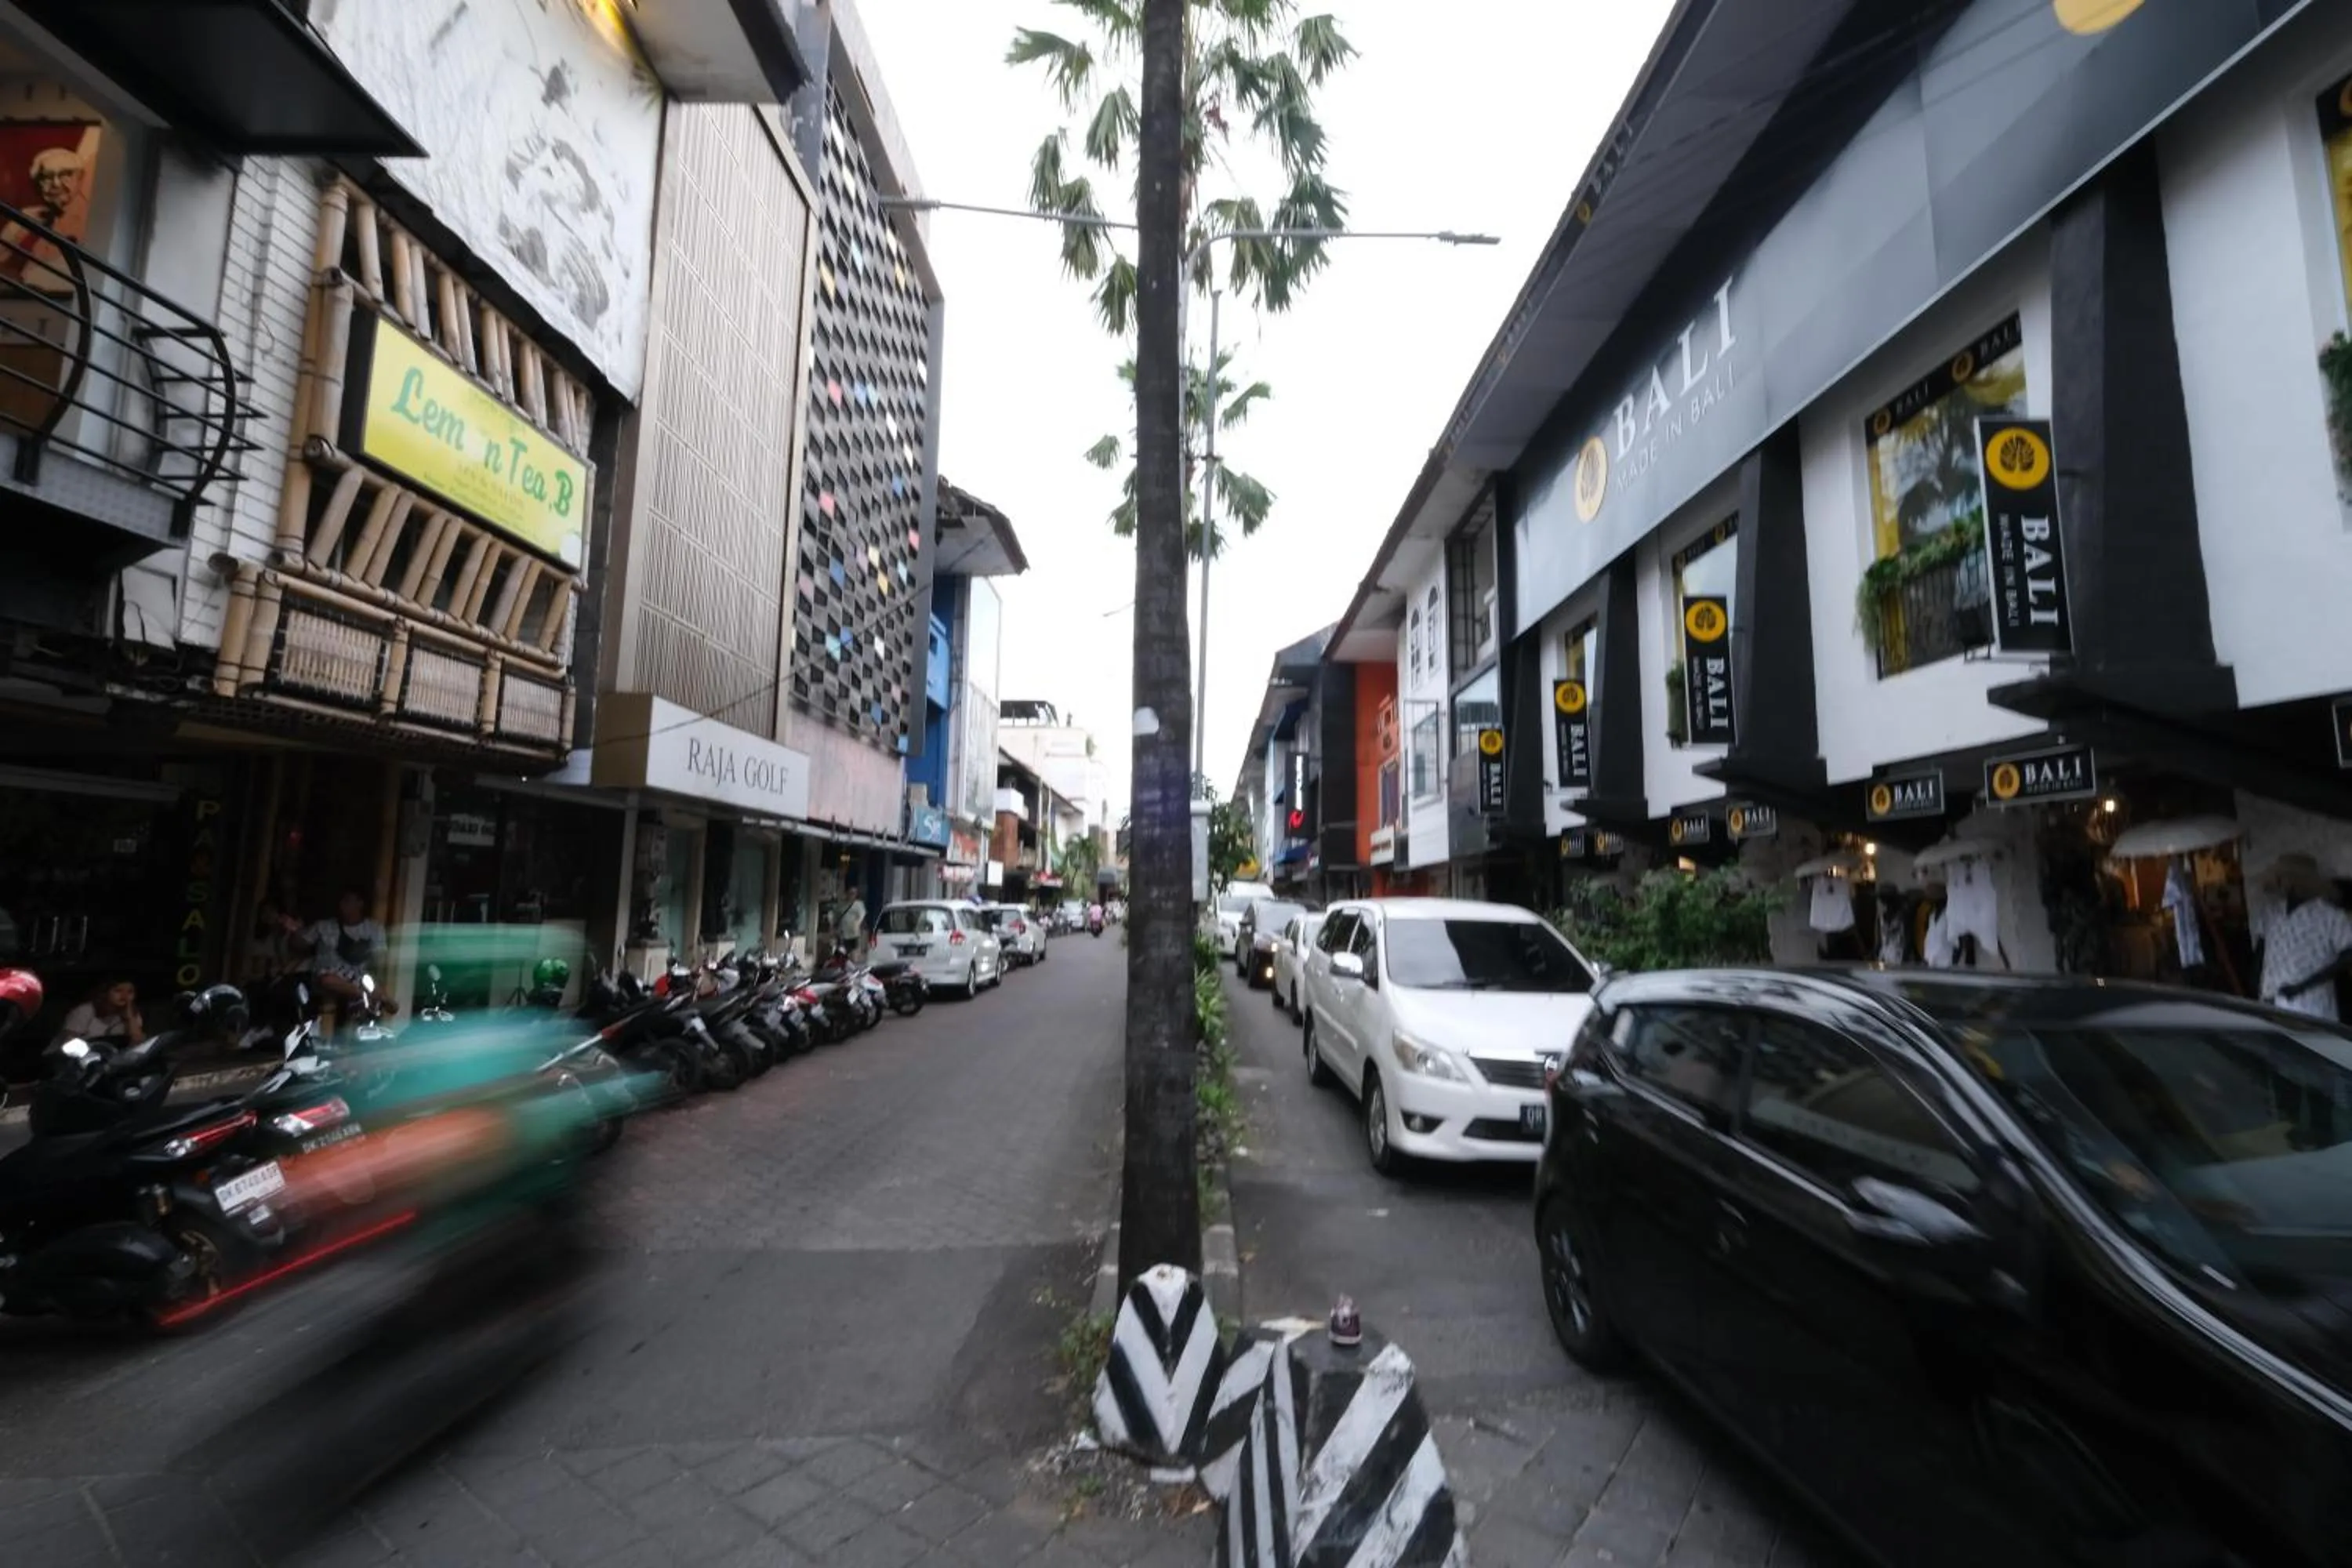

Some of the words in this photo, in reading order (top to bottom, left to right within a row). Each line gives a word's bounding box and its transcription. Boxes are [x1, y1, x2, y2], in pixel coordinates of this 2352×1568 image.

[1613, 276, 1736, 463] BALI
[1666, 412, 1682, 441] IN
[1691, 361, 1735, 426] BALI
[2020, 514, 2059, 626] BALI
[1706, 657, 1729, 728] BALI
[688, 737, 736, 787] RAJA
[744, 755, 789, 795] GOLF
[1570, 724, 1588, 776] BALI
[2024, 756, 2082, 783] BALI
[1893, 780, 1934, 802] BALI
